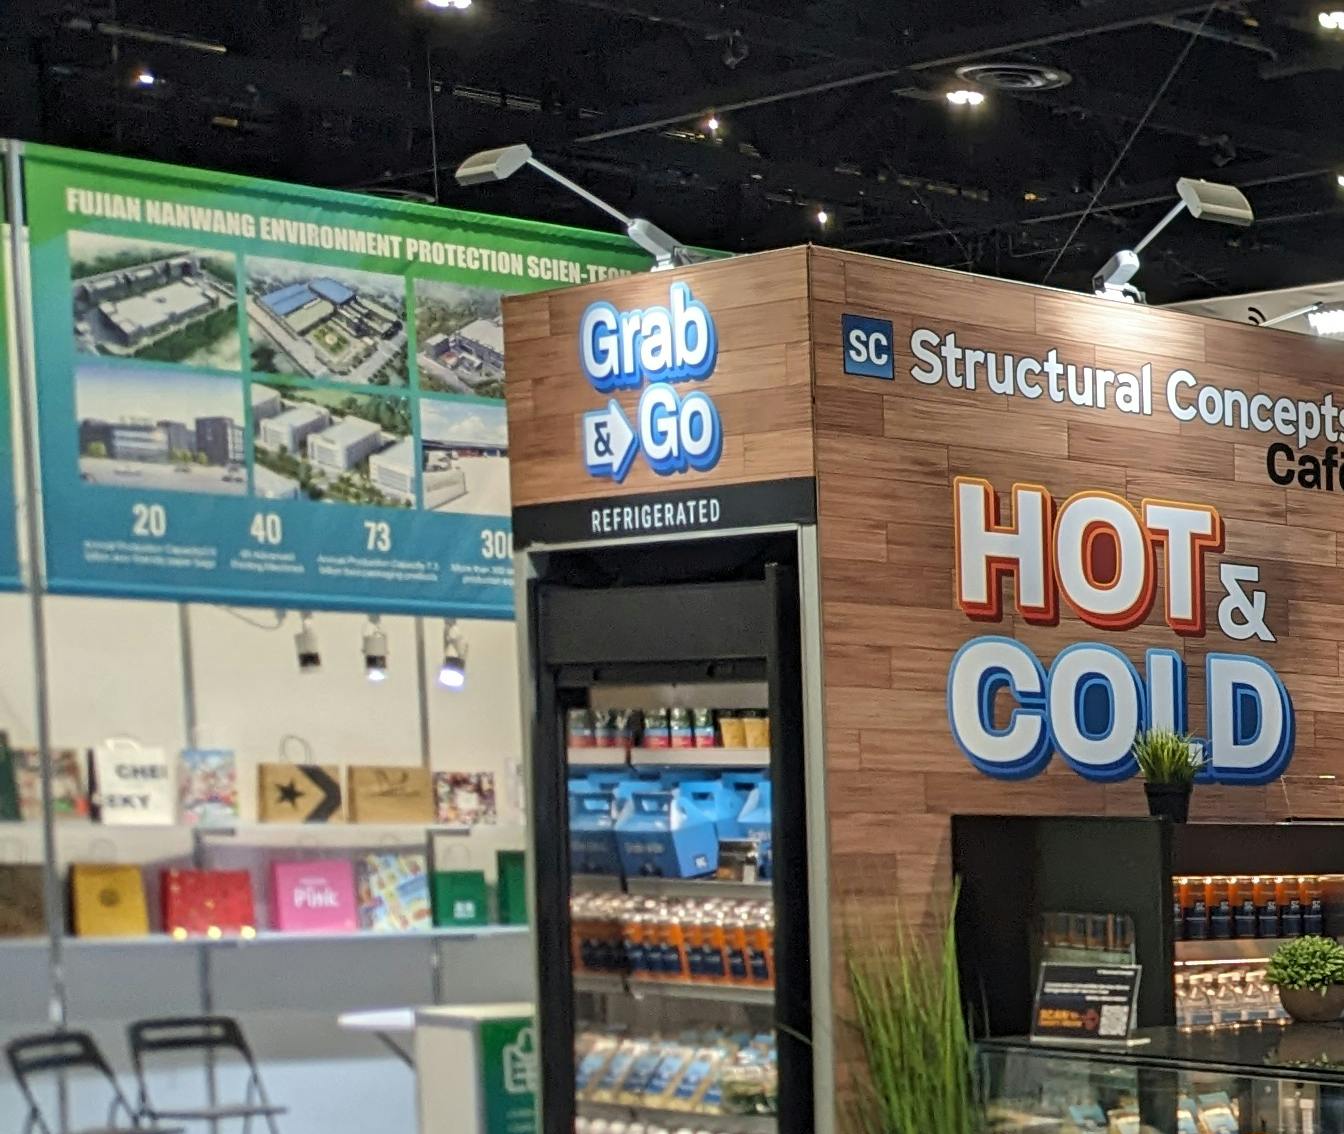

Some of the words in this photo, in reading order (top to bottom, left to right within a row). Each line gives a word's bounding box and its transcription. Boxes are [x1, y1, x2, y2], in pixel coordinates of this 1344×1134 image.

[66, 187, 141, 222] FUJIAN
[146, 199, 256, 239] NANWANG
[260, 215, 402, 259] ENVIRONMENT
[405, 237, 524, 277] PROTECTION
[581, 282, 716, 388] Grab
[848, 328, 889, 366] SC
[909, 327, 1153, 417] Structural
[593, 420, 614, 456] &
[640, 386, 721, 474] Go
[132, 503, 167, 537] 20
[250, 512, 282, 545] 40
[363, 521, 392, 552] 73
[591, 498, 721, 533] REFRIGERATED
[953, 477, 1222, 636] HOT
[1217, 562, 1277, 643] &
